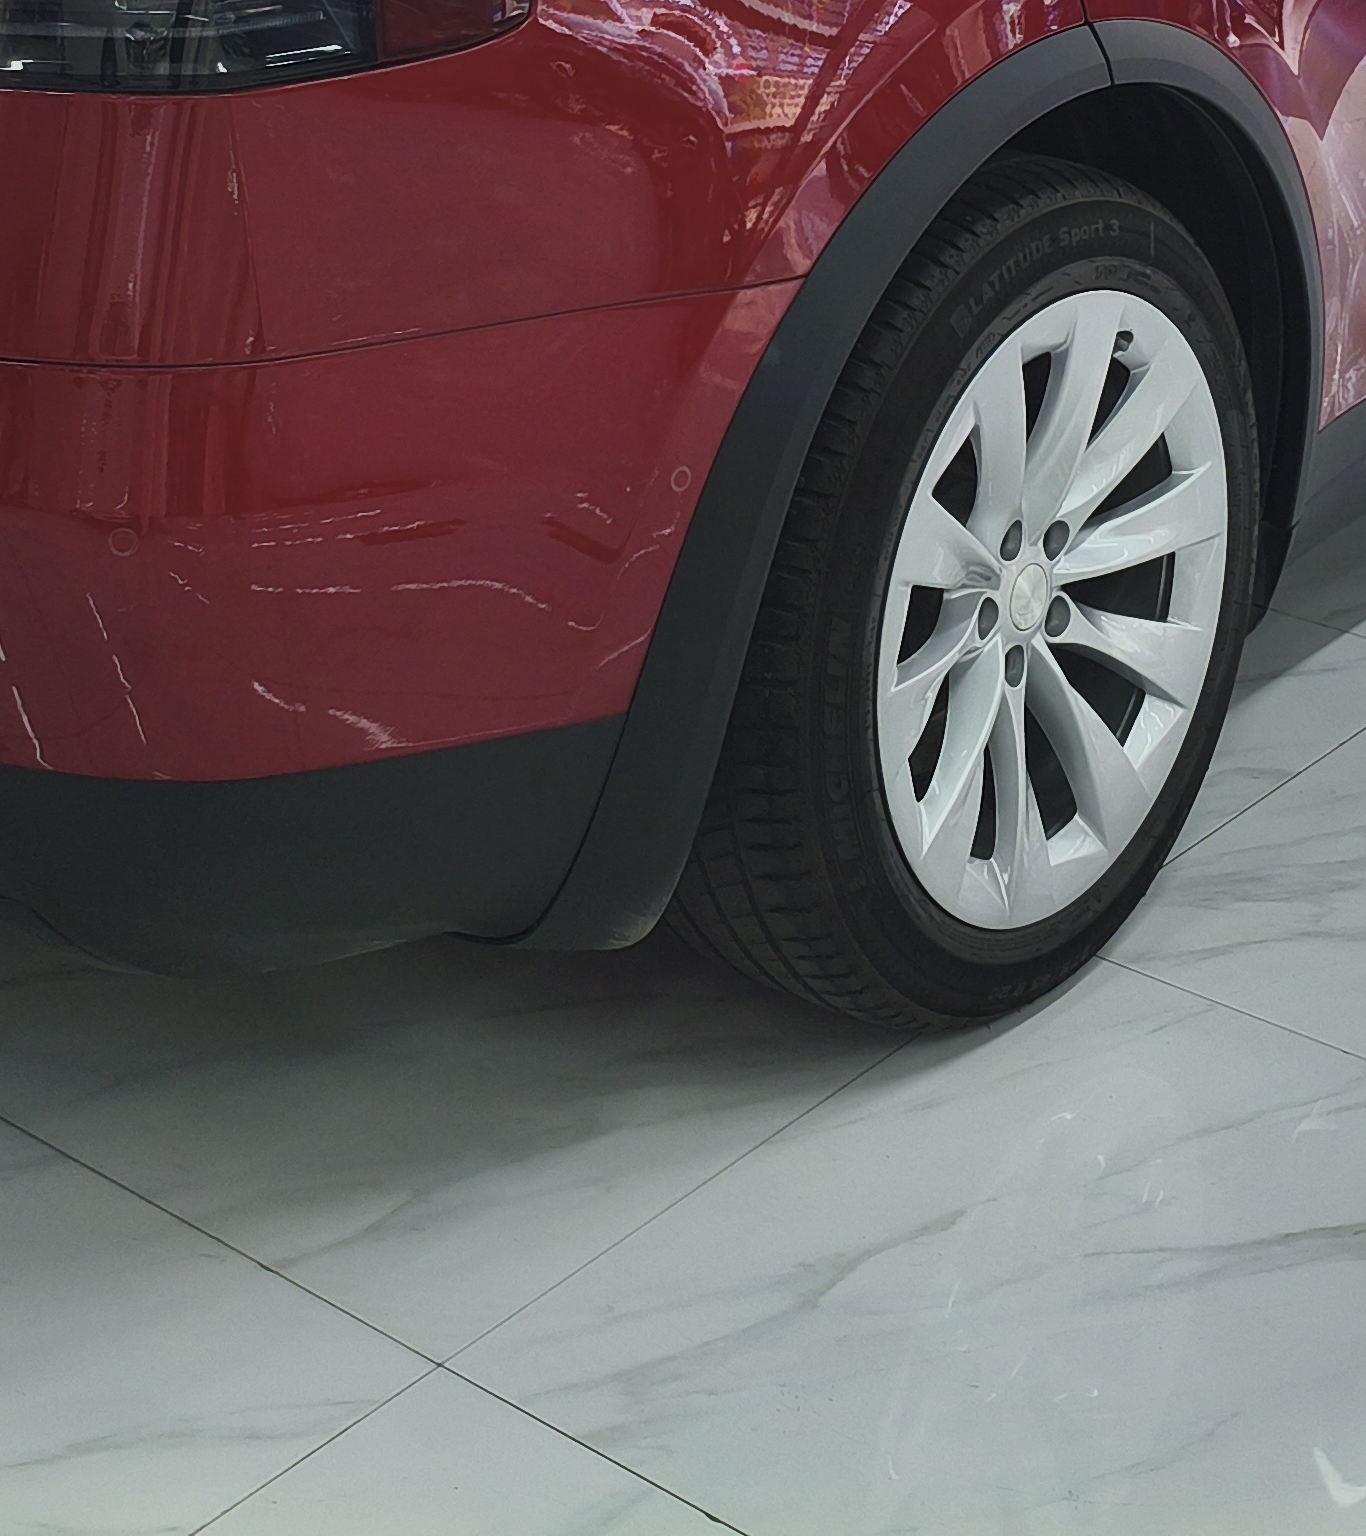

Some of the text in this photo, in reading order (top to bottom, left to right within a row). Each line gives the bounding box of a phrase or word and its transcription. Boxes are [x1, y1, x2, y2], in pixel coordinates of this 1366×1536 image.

[968, 219, 1121, 317] LATITUDE Sport 3
